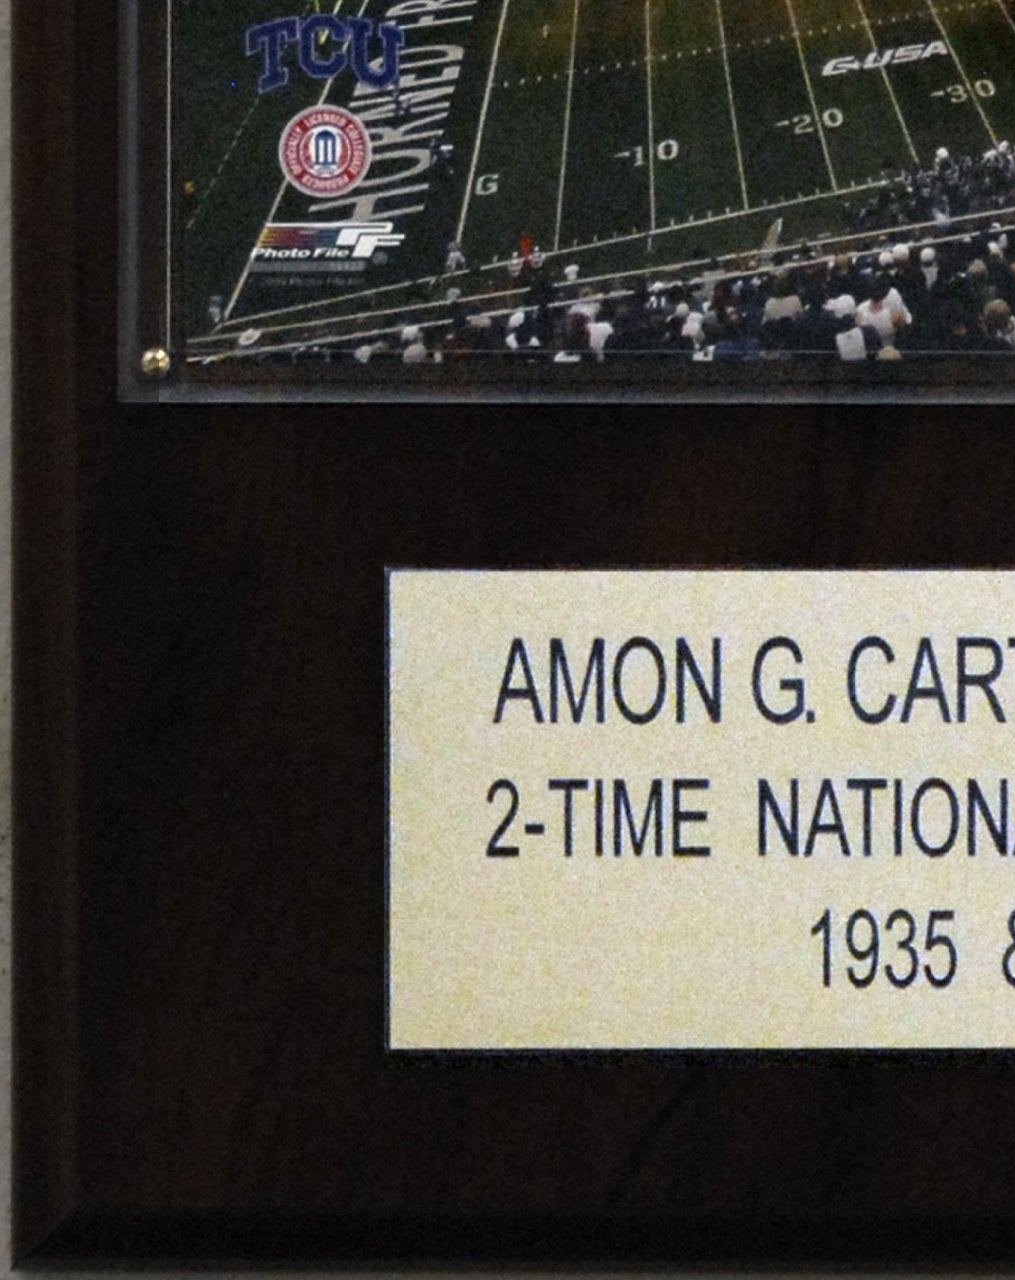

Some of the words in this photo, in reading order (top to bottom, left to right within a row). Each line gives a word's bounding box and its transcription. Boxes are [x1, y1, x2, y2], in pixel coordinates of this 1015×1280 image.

[246, 13, 405, 95] TCU
[475, 173, 500, 196] G
[251, 247, 311, 259] Photo
[312, 247, 350, 259] File
[492, 637, 721, 724] AMON
[752, 637, 815, 724] G.
[486, 778, 711, 857] 2-TIME
[812, 909, 957, 988] 1935
